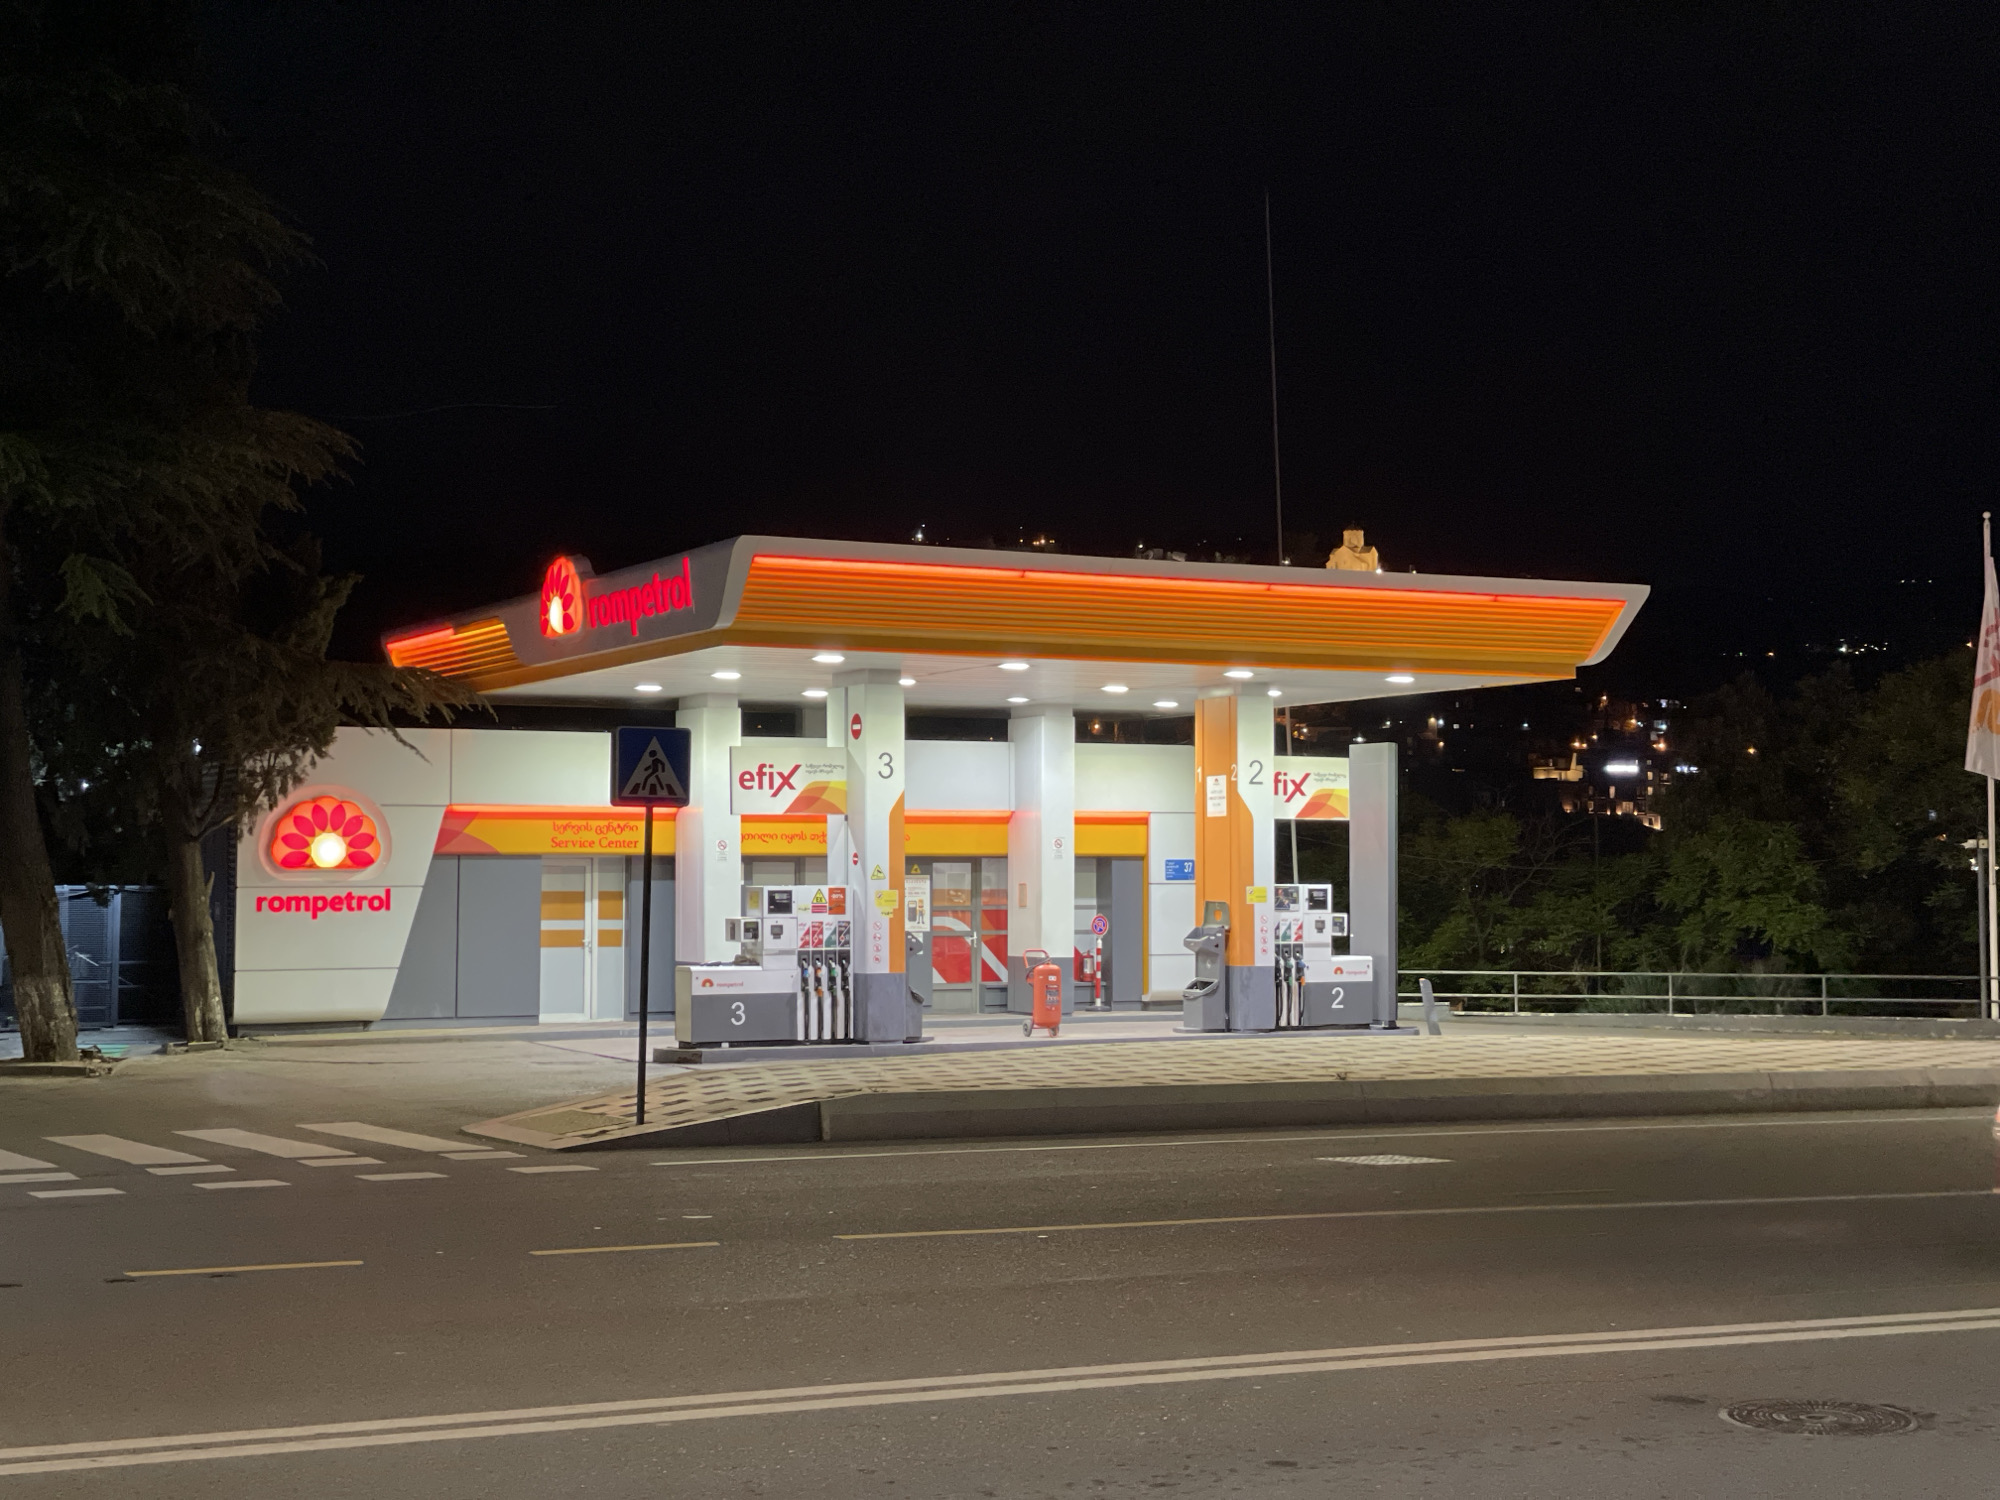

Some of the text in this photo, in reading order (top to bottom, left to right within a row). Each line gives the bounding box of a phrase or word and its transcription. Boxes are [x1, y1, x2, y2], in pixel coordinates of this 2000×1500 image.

[589, 556, 693, 637] rompetrol
[878, 752, 894, 779] 3
[1249, 760, 1264, 785] 2
[738, 763, 802, 798] efix
[1273, 771, 1311, 803] fix
[550, 836, 640, 848] Service Center
[741, 832, 778, 844] თილი
[255, 888, 391, 920] rompetrol
[1331, 987, 1344, 1009] 2
[730, 1001, 746, 1026] 3
